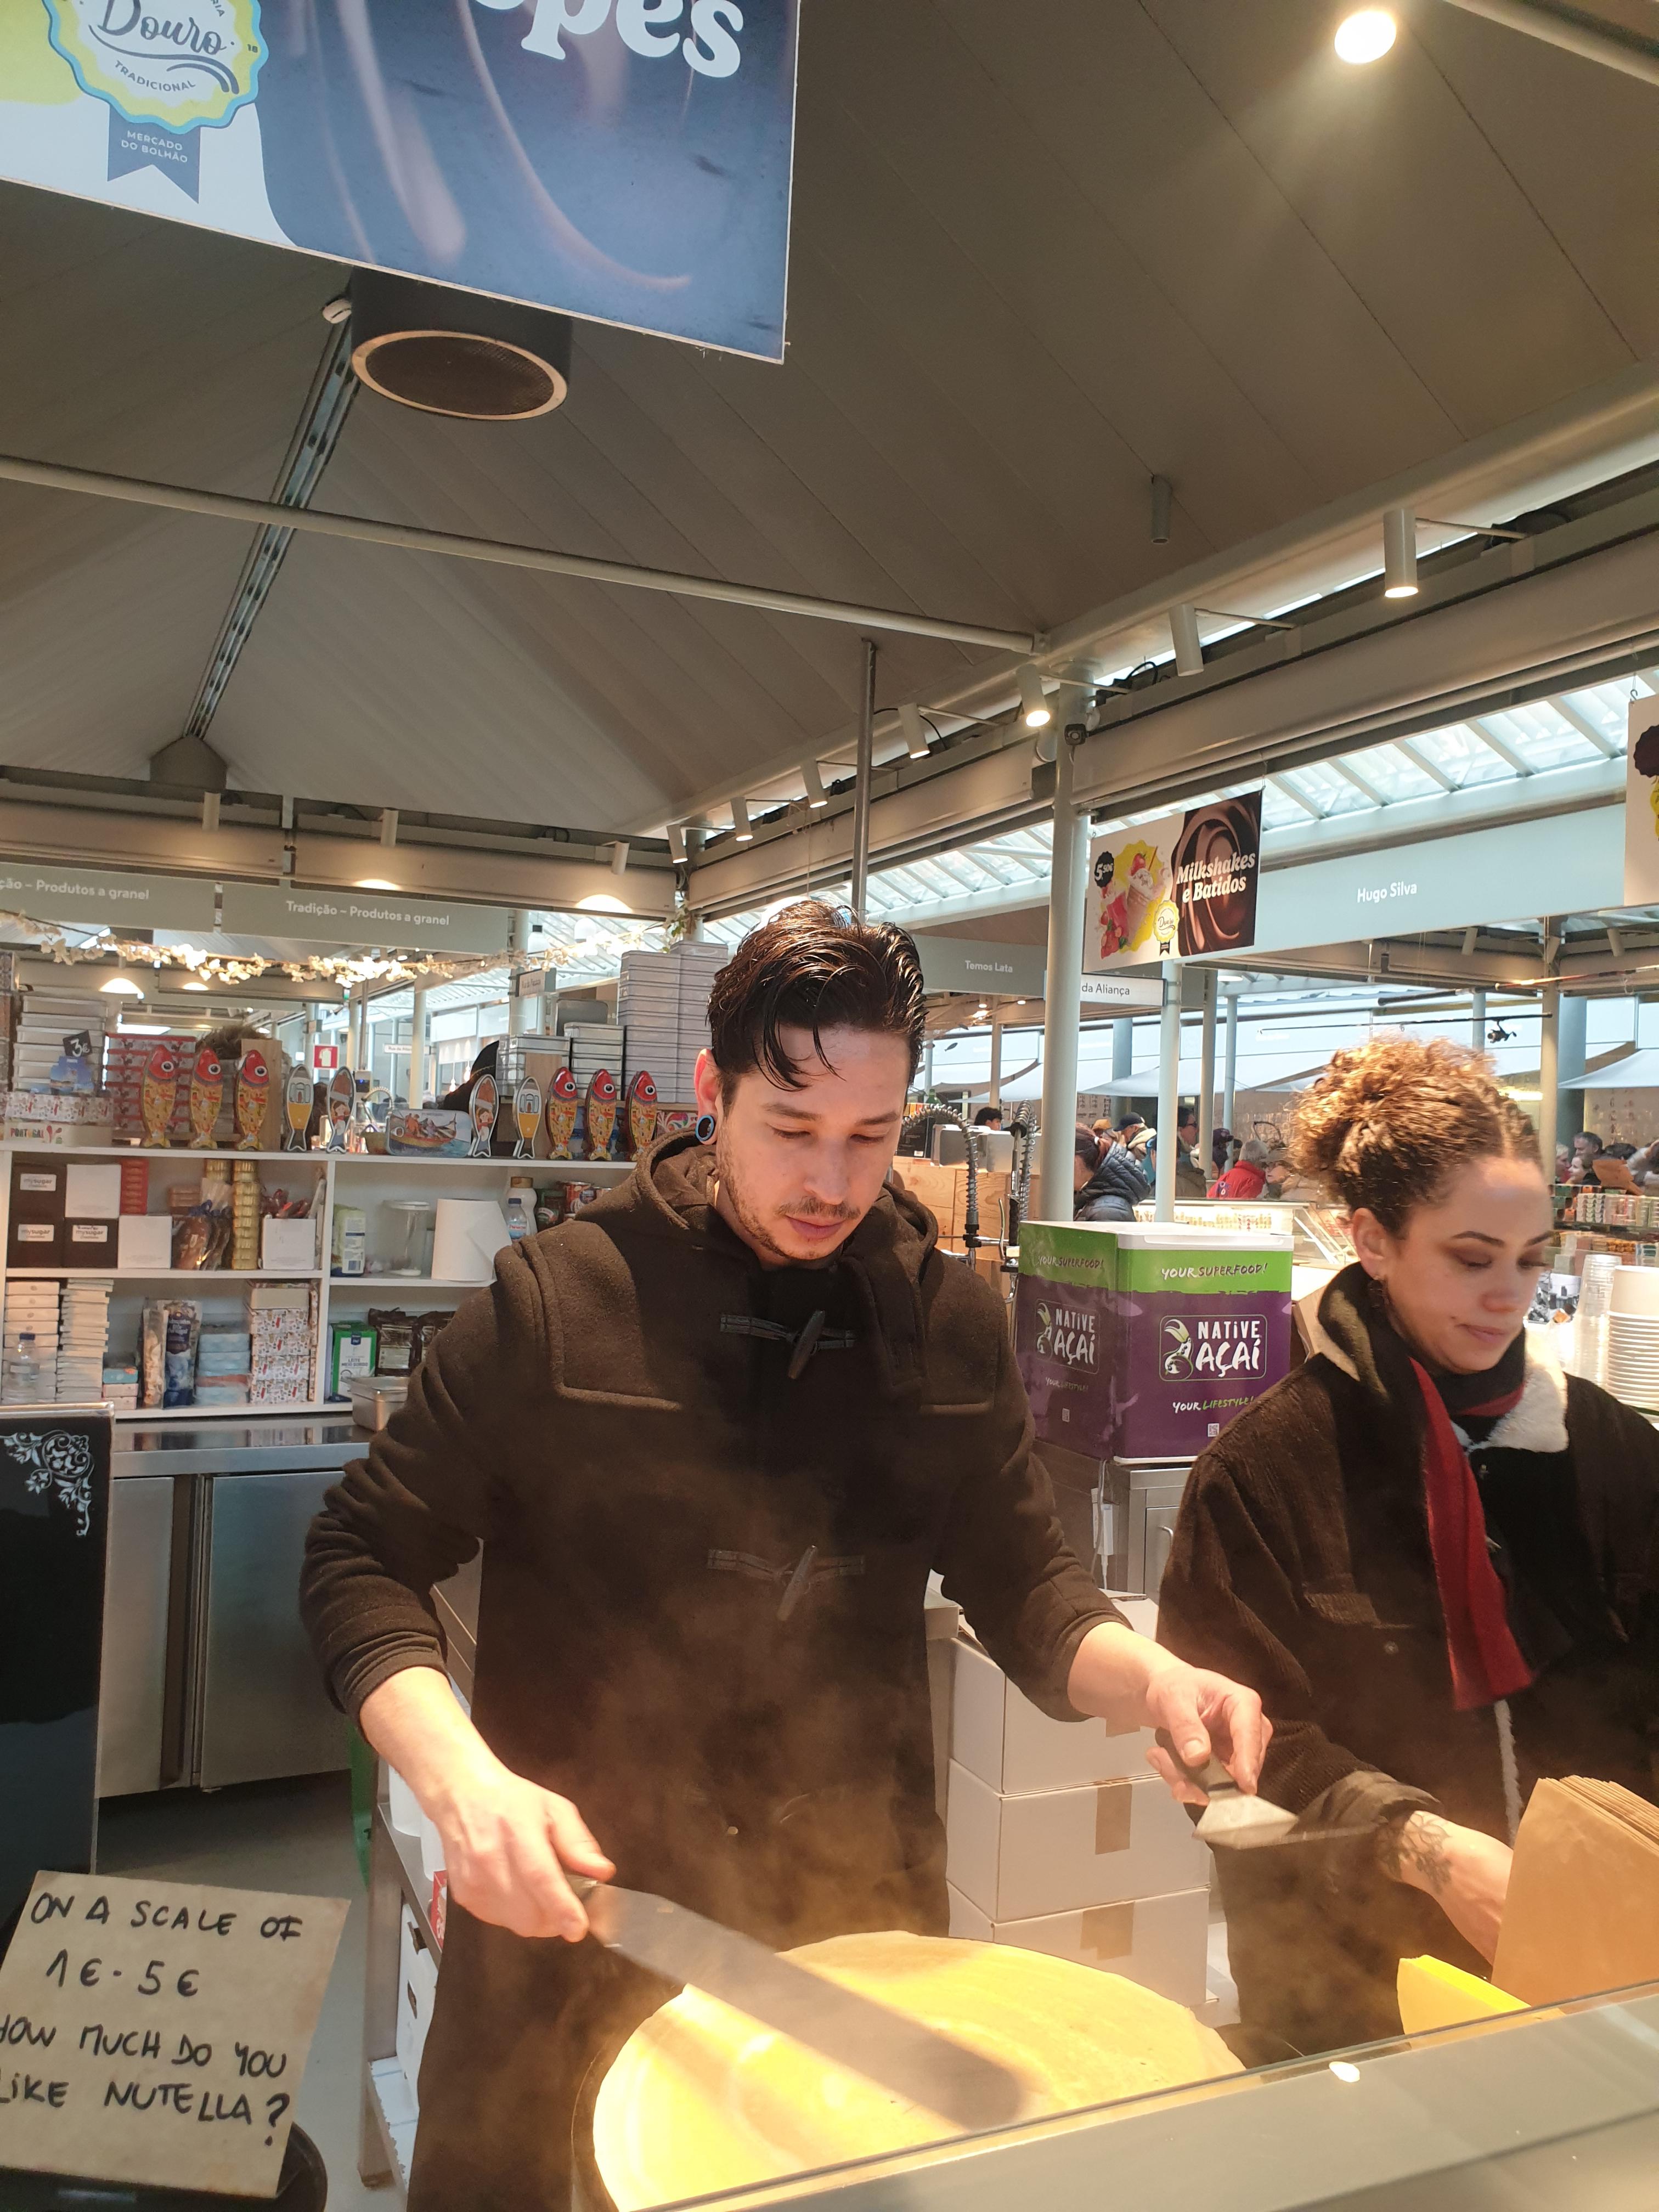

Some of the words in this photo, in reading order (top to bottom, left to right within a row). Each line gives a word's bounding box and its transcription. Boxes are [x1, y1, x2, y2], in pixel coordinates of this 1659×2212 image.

[97, 0, 227, 55] Douro
[472, 0, 744, 78] pes
[115, 60, 196, 92] TRADICIONAL
[121, 139, 138, 150] DO
[142, 145, 188, 163] BOLHÃO
[127, 130, 183, 151] MERCADO
[1176, 851, 1256, 884] Milkshakes
[37, 879, 94, 895] Produtos
[98, 888, 105, 896] a
[109, 889, 149, 900] granel
[1182, 888, 1190, 904] e
[1193, 874, 1246, 901] Batidos
[1357, 888, 1387, 904] Hugo
[1390, 881, 1417, 898] Silva
[286, 901, 337, 916] Tradição
[350, 906, 402, 921] Produtos
[414, 916, 449, 926] granel
[965, 960, 992, 971] Temos
[995, 962, 1013, 973] Lata
[1081, 983, 1093, 992] da
[1096, 984, 1130, 996] Aliança
[70, 1038, 90, 1057] 3€
[10, 1128, 44, 1138] PORTUGAL
[1039, 1255, 1059, 1266] YOUR
[1058, 1256, 1104, 1269] SUPERFOOD!
[1161, 1268, 1198, 1280] YOUR
[1198, 1263, 1268, 1277] SUPERFOOD!
[1172, 1402, 1201, 1414] YOUR
[31, 1892, 75, 1923] ON
[85, 1895, 110, 1925] A
[131, 1900, 237, 1936] SCALE
[260, 1915, 303, 1942] OF
[78, 2023, 161, 2059] MUCH
[171, 2034, 212, 2066] DO
[235, 2041, 287, 2078] YOU
[104, 2080, 290, 2147] NUTELLA?
